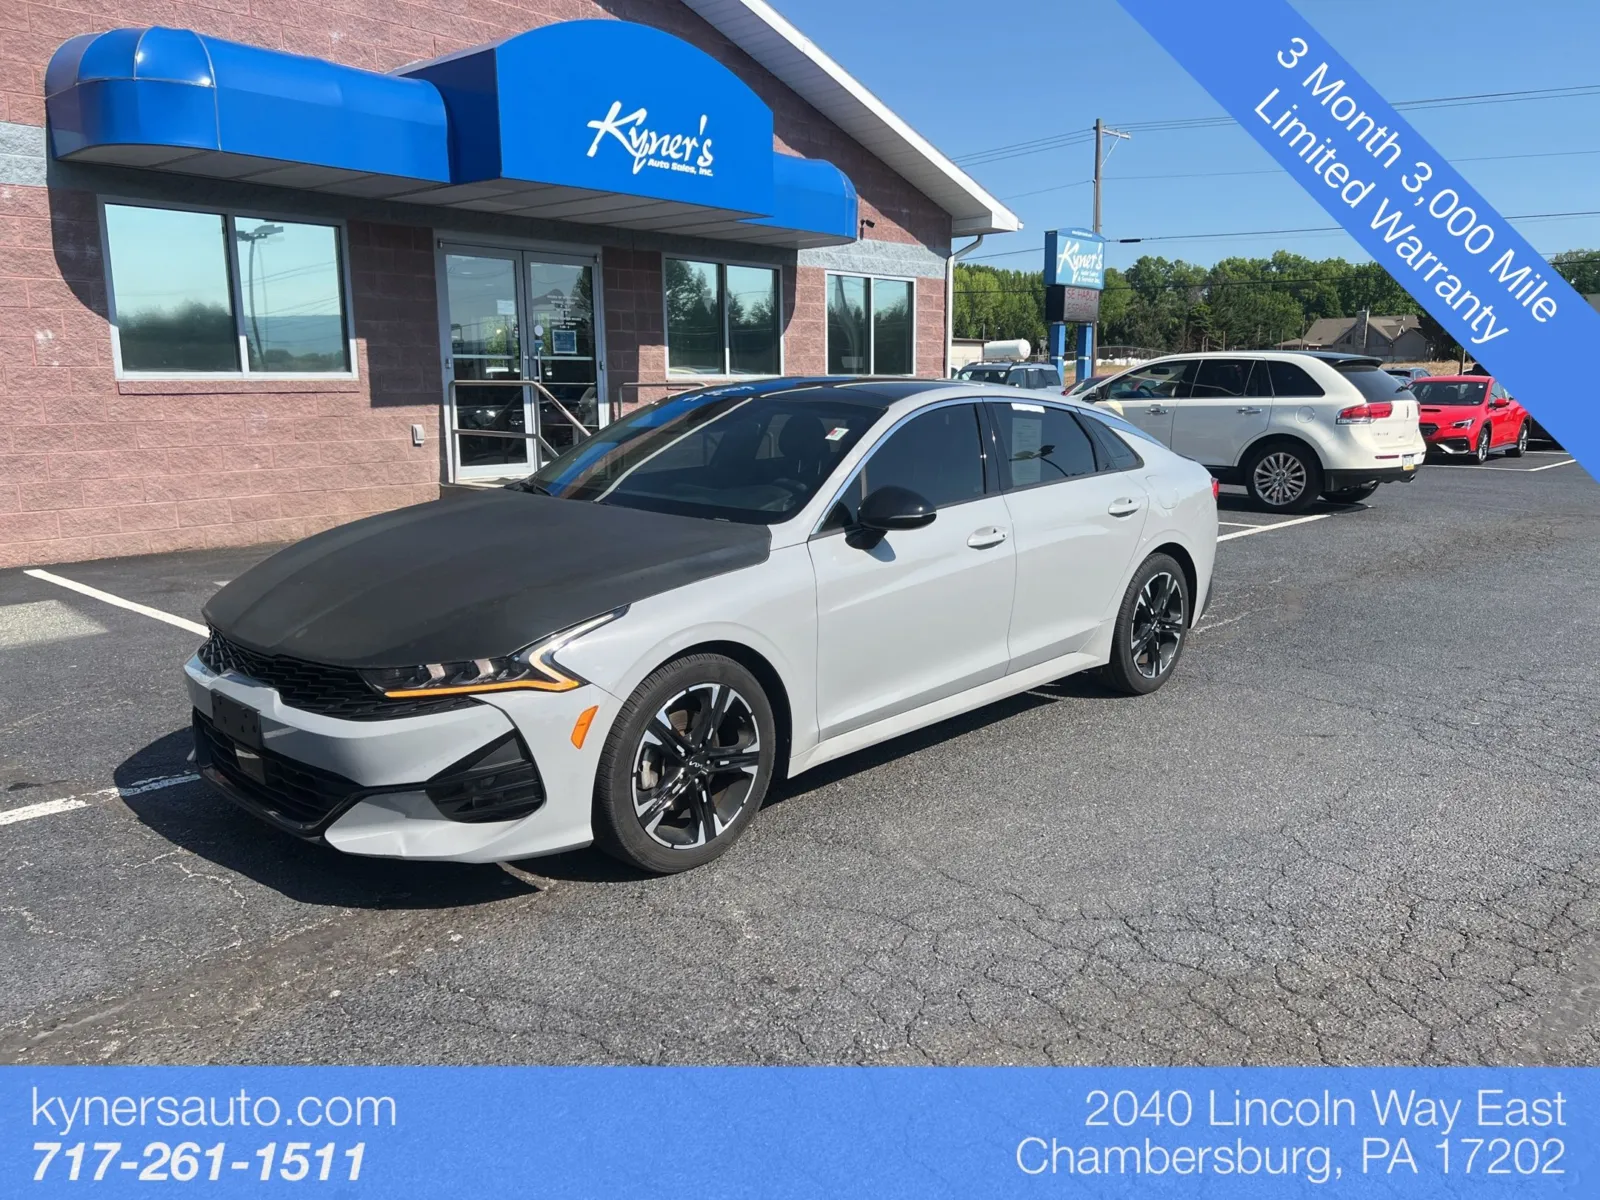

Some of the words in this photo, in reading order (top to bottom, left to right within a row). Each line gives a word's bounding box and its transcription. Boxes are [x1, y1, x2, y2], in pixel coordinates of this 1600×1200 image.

[586, 100, 714, 175] Kyner's
[647, 158, 670, 169] Auto
[671, 162, 697, 175] Sales,
[1057, 240, 1104, 284] Kyner's
